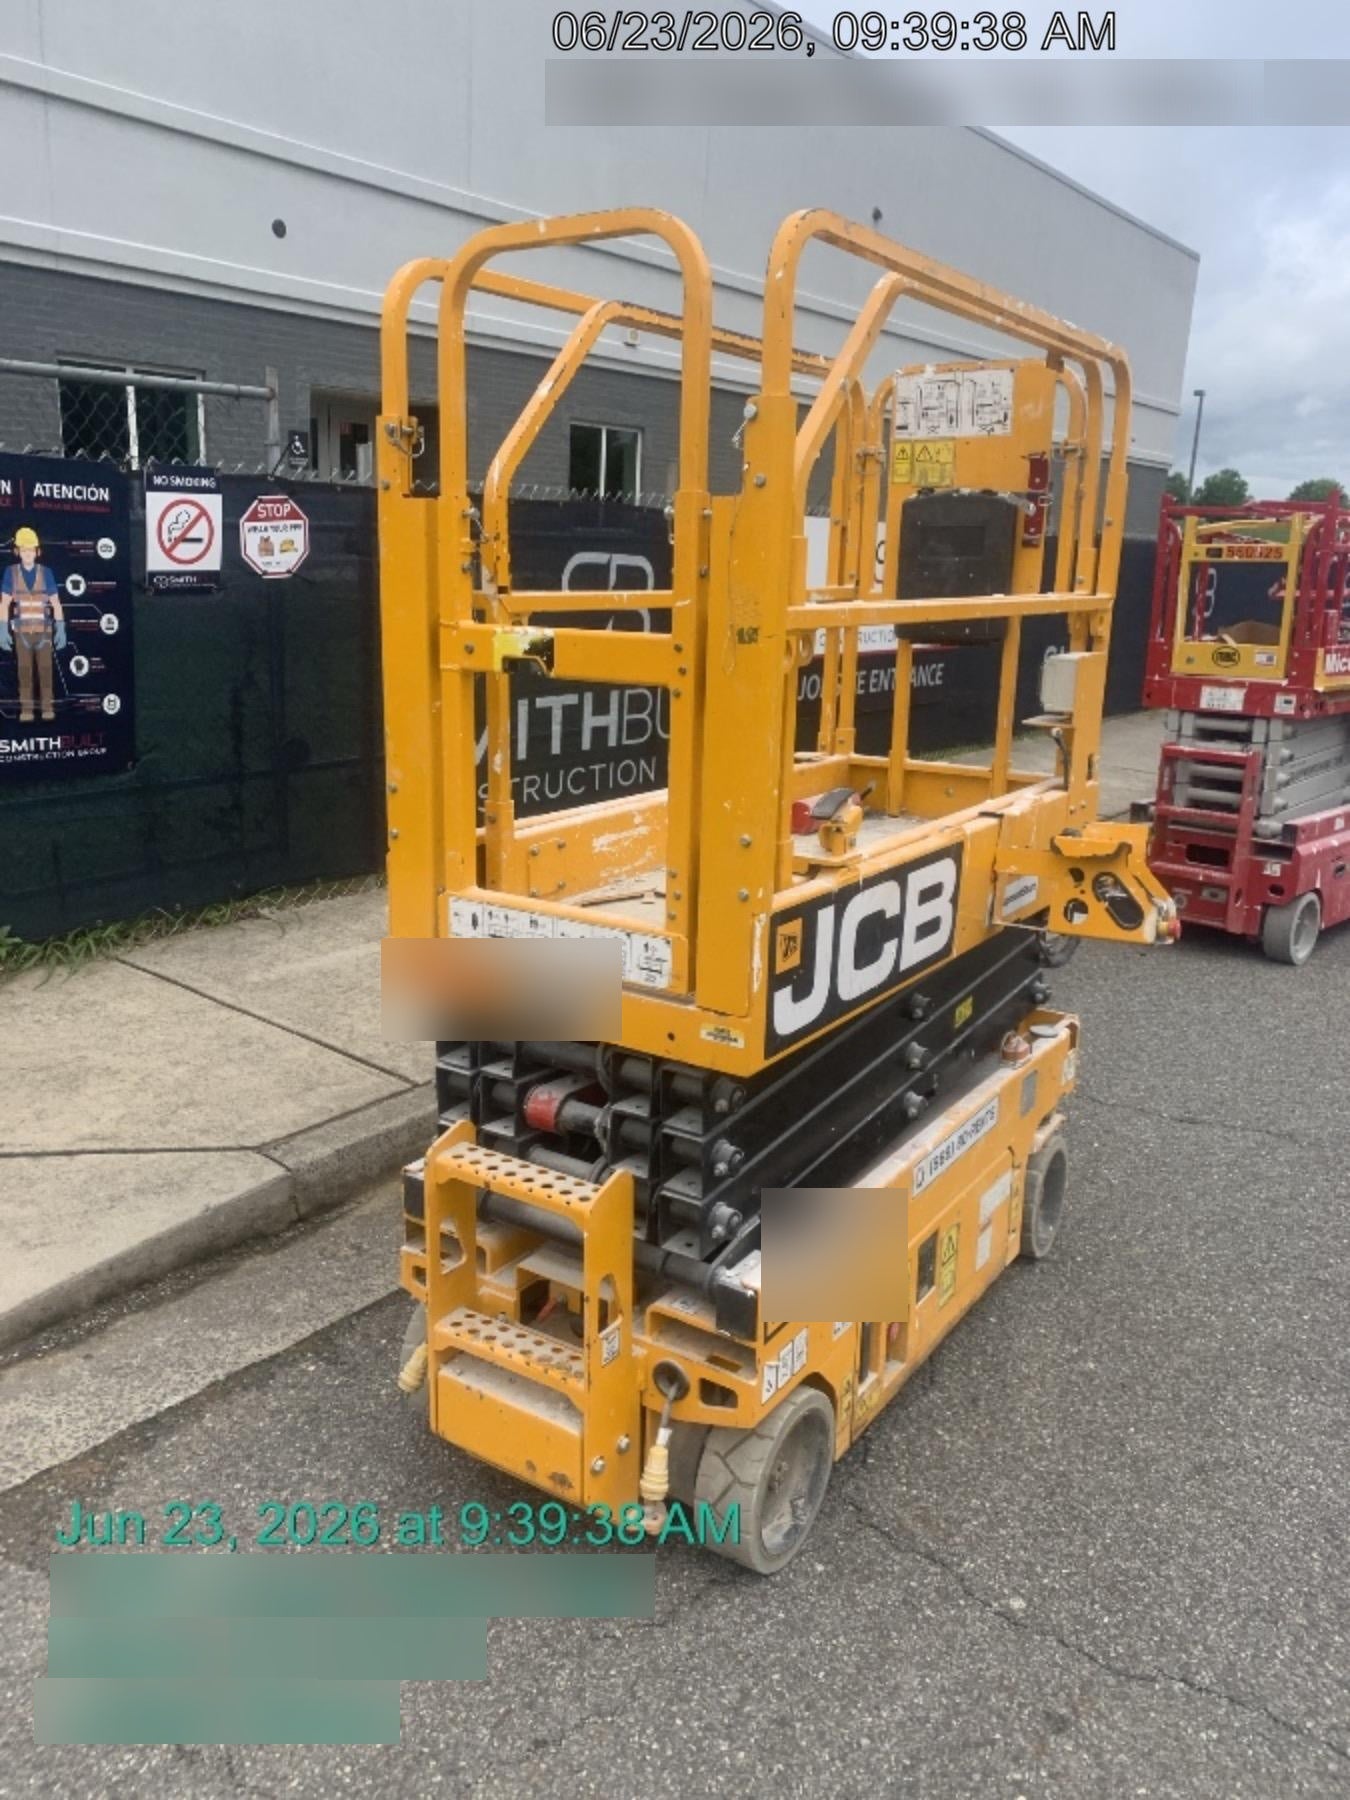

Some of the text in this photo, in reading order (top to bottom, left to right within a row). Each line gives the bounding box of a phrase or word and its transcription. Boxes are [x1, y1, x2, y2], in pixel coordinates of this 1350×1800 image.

[153, 475, 169, 486] NO
[33, 482, 110, 502] ATENCIÓN
[256, 503, 291, 518] STOP
[869, 663, 945, 694] ENTANCE
[773, 857, 957, 1037] JCB
